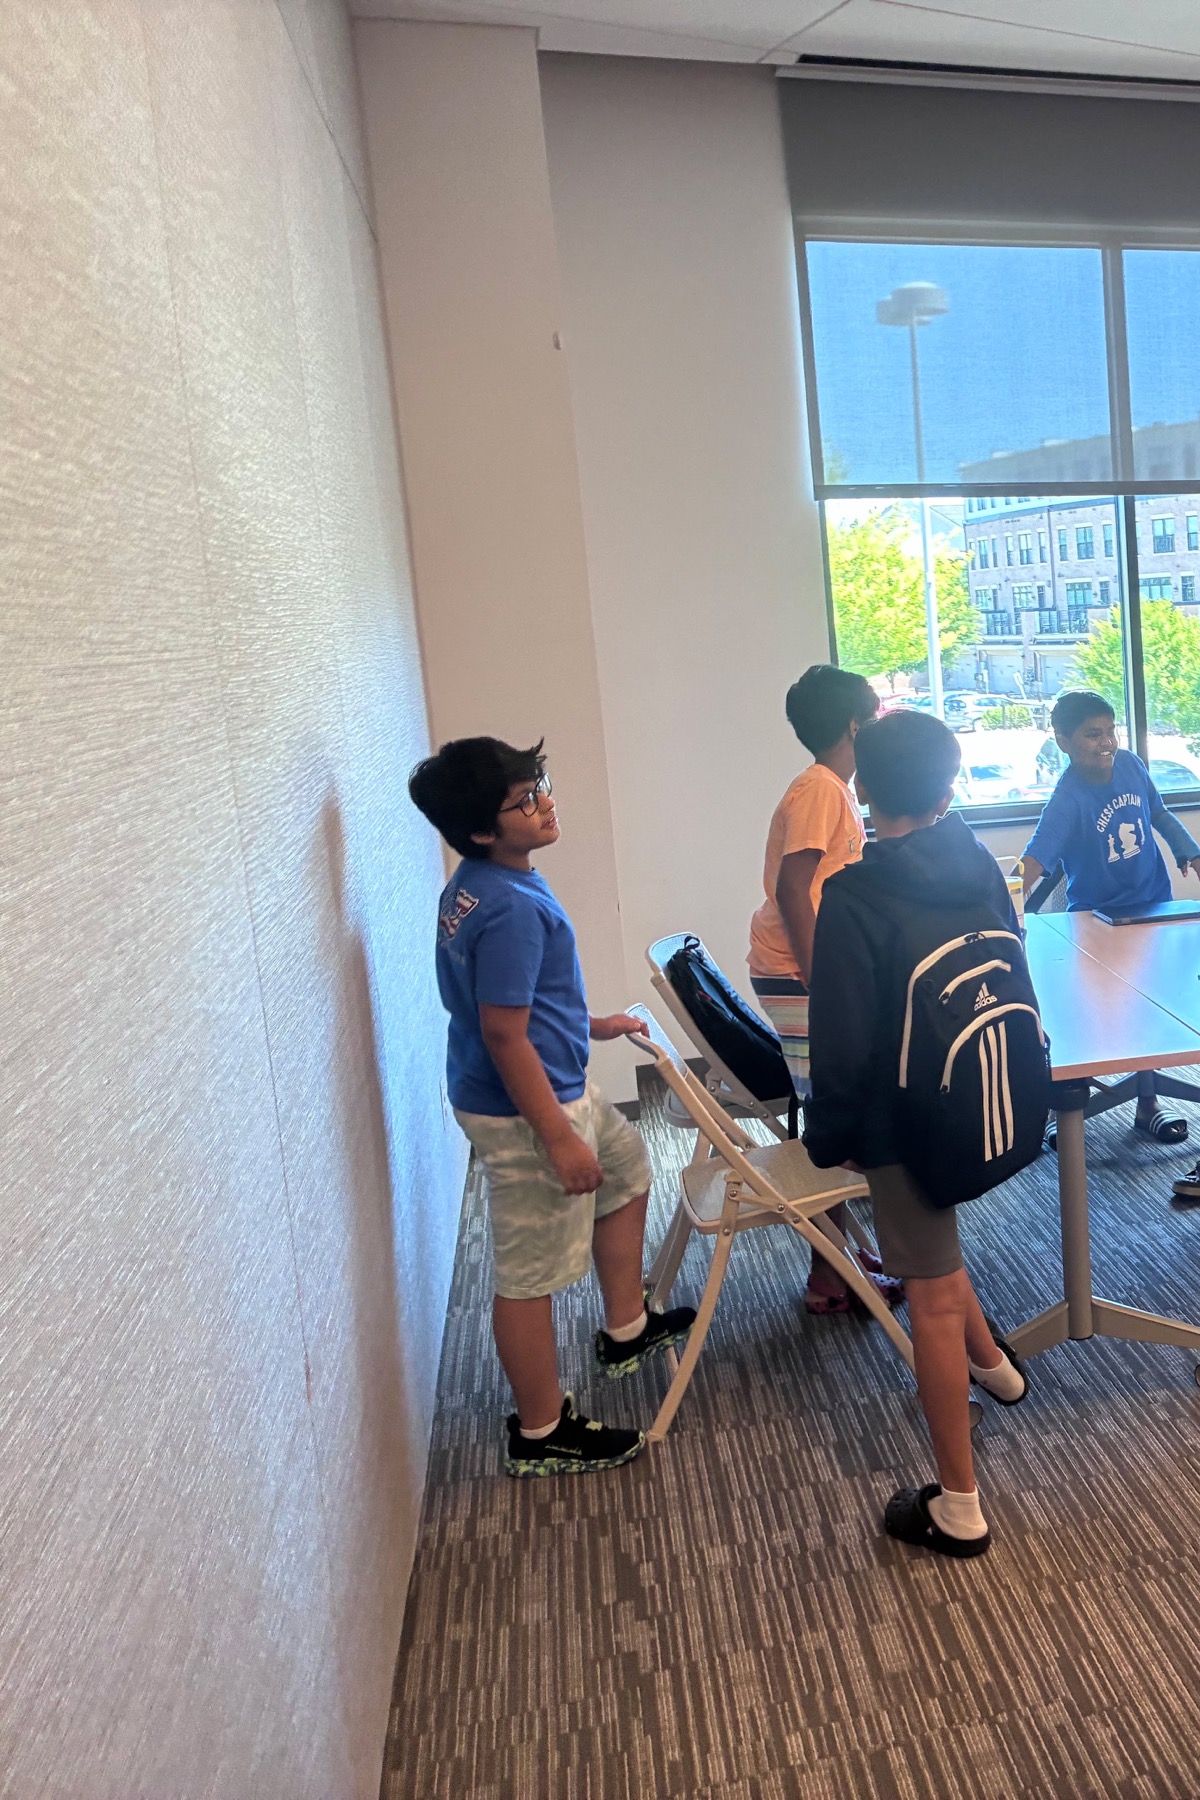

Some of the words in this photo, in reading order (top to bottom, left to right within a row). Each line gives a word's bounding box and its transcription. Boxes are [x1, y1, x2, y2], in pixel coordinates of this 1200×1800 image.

[1096, 804, 1114, 832] CHESS
[1112, 793, 1141, 809] CAPTAIN
[974, 995, 998, 1011] adidas
